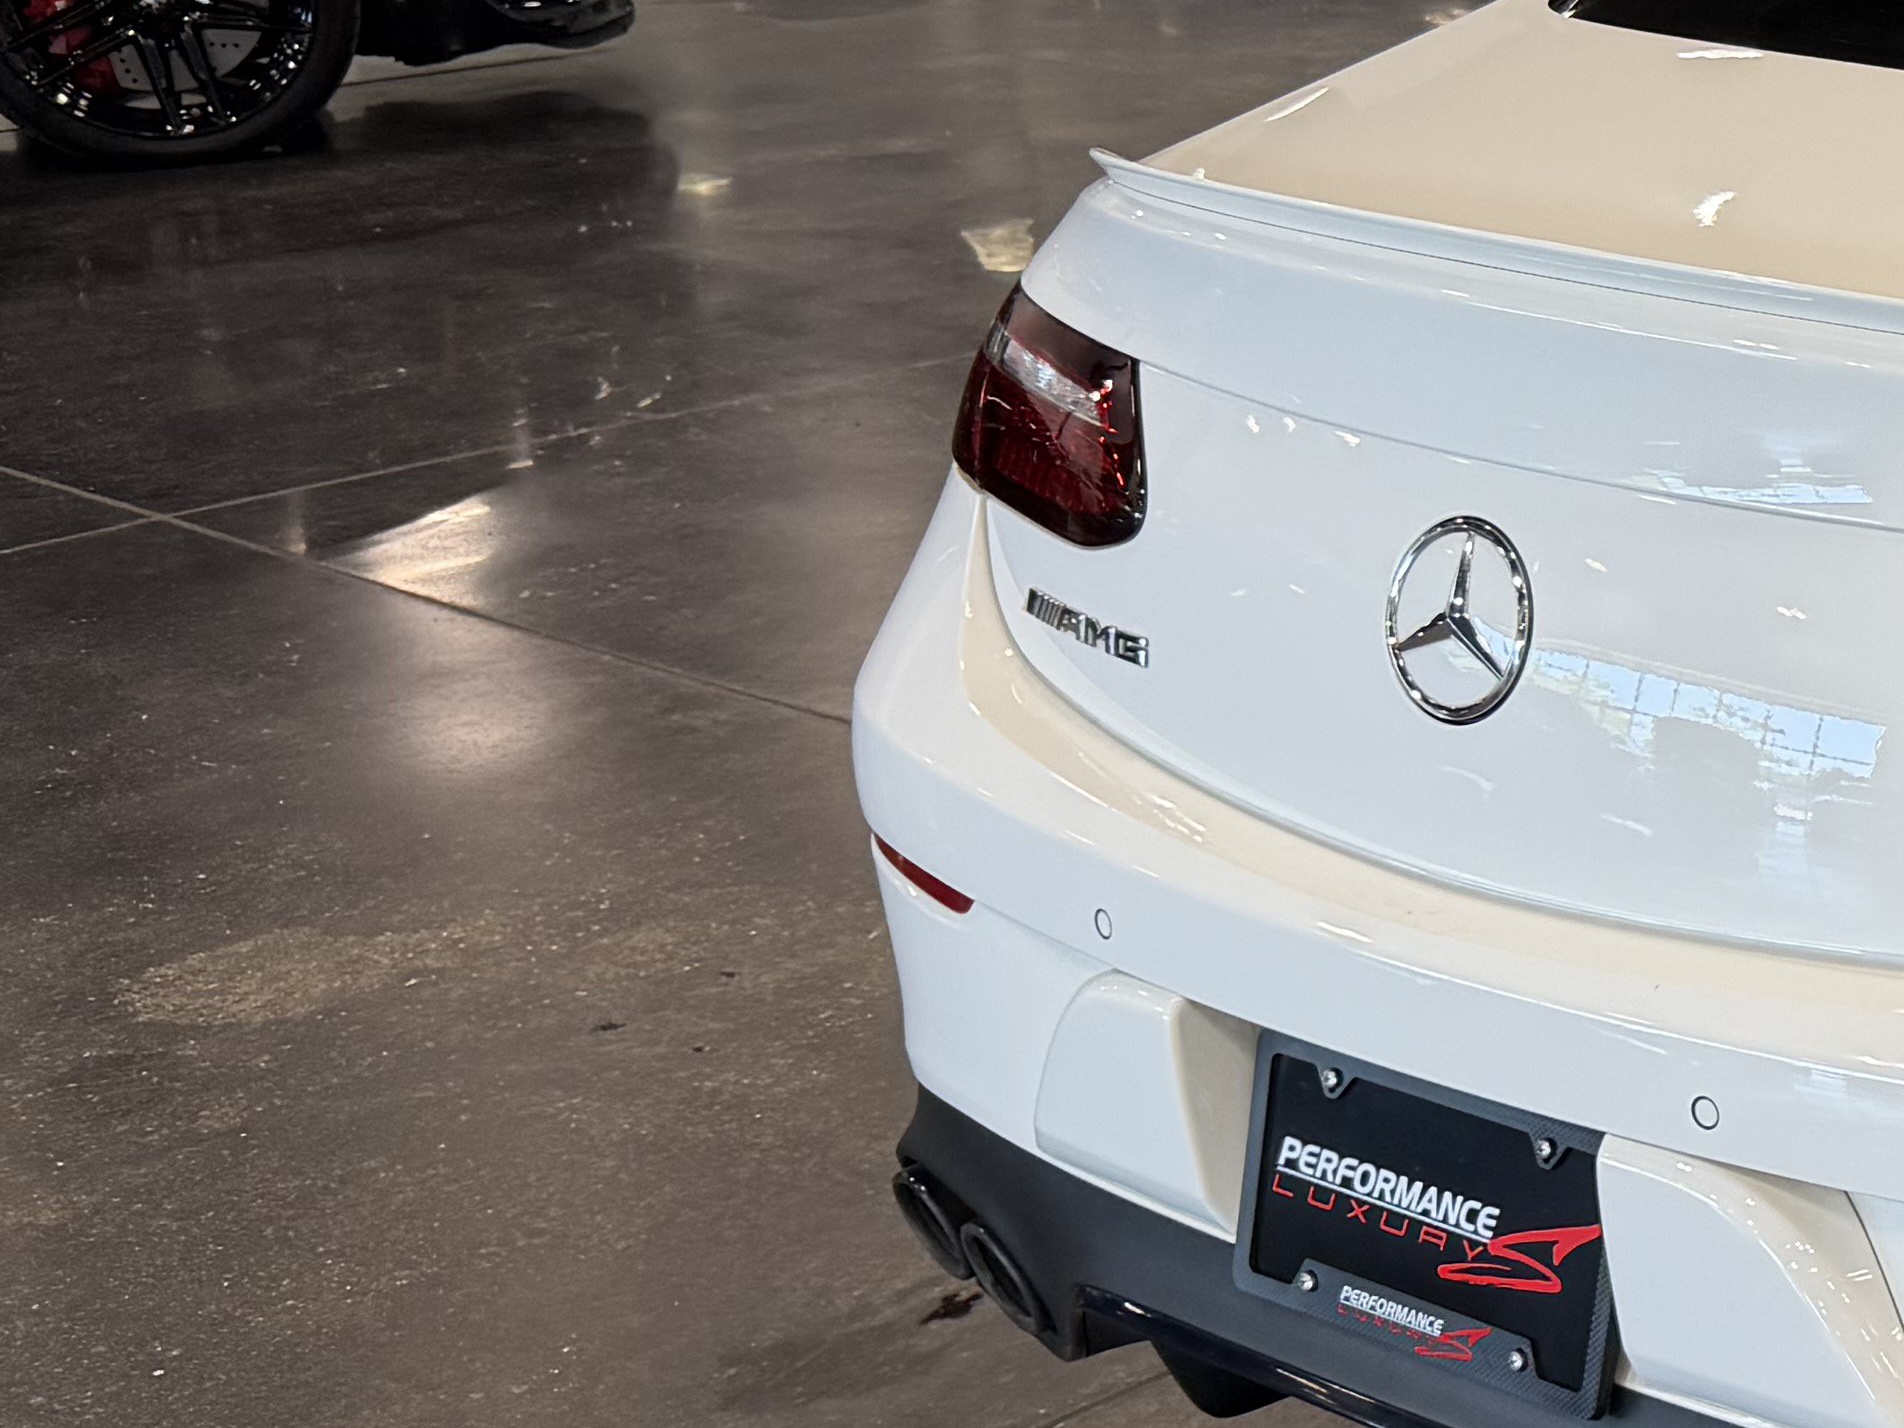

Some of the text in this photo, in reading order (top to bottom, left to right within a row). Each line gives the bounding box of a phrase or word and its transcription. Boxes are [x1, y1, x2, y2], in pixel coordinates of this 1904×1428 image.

[1056, 605, 1149, 669] AMG
[1272, 1173, 1485, 1261] LUXURY
[1277, 1134, 1501, 1238] PERFORMANCE
[1340, 1285, 1445, 1334] PERFORMANCE
